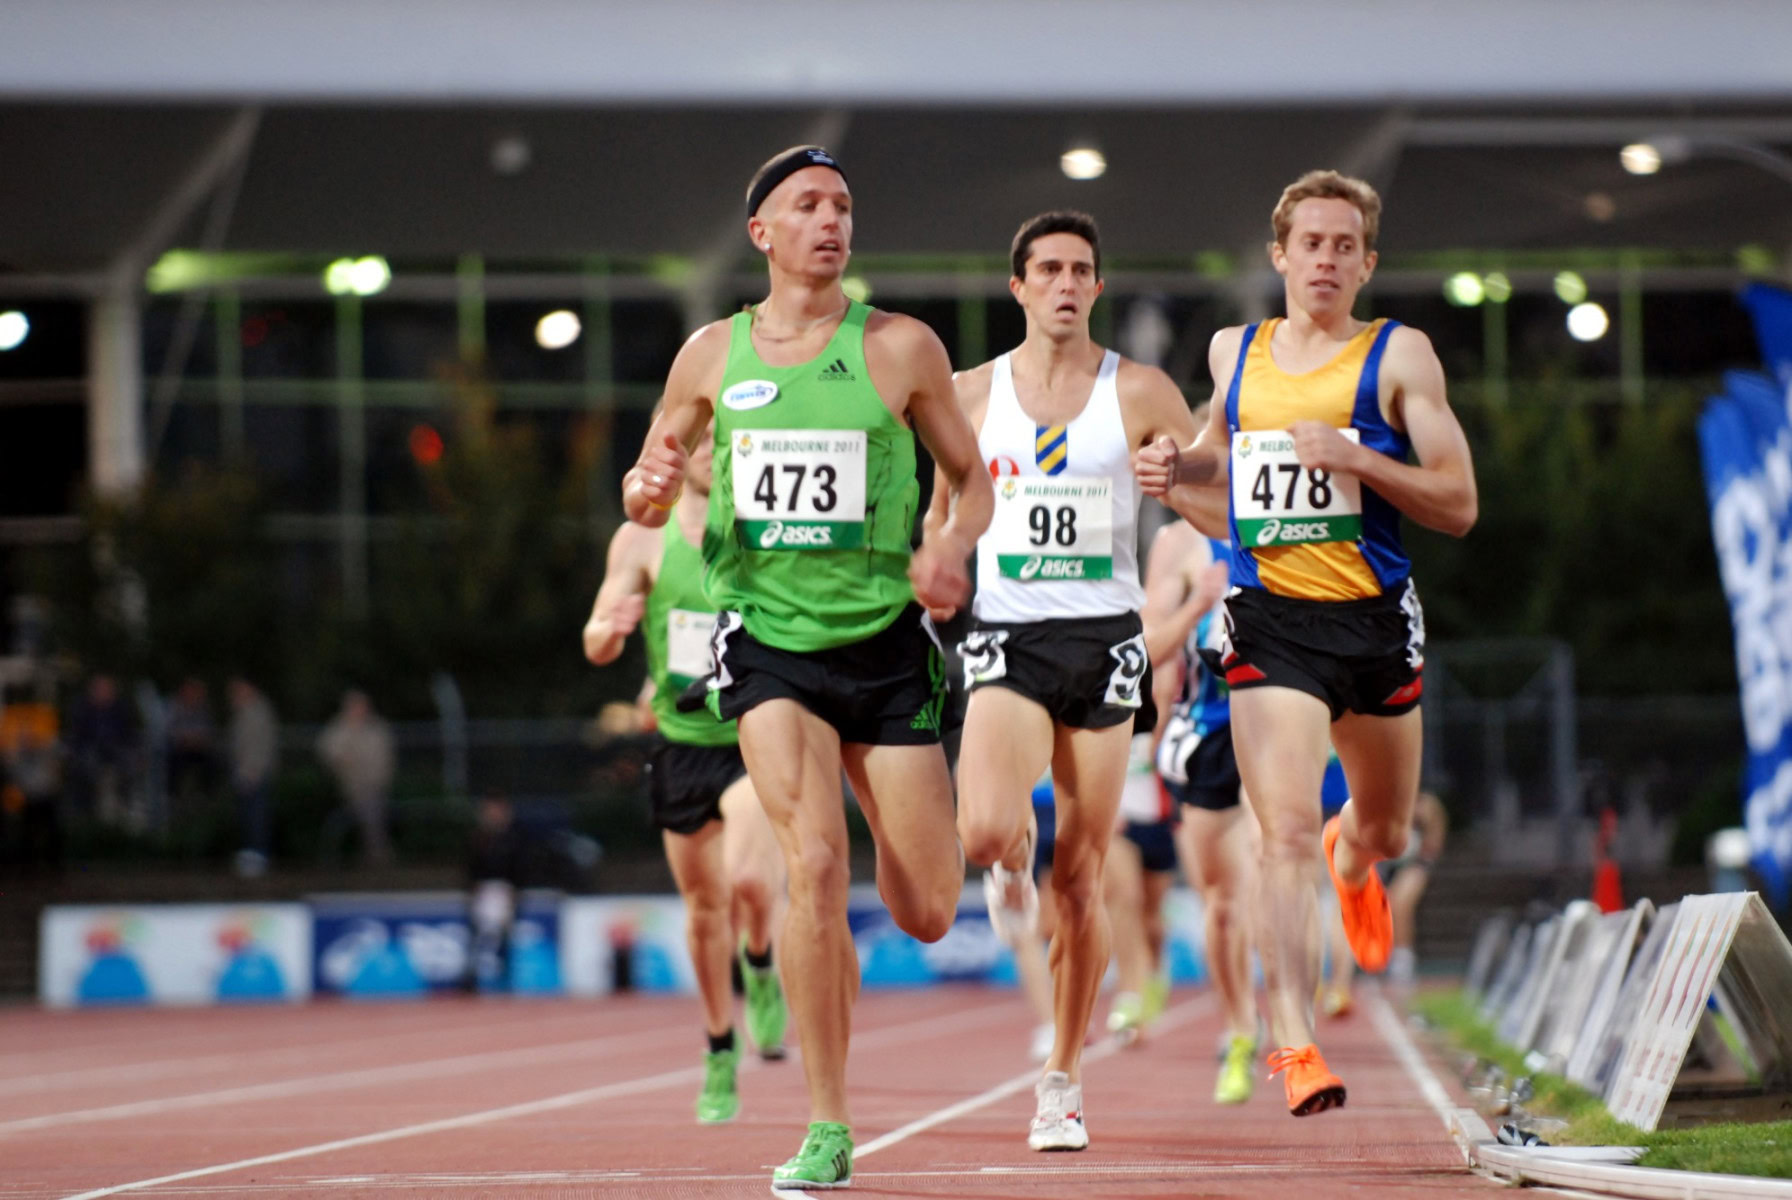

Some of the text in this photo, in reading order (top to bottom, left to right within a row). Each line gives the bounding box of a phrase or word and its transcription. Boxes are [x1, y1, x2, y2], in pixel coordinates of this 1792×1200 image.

[761, 439, 860, 453] MELBOURNE 2011
[1259, 440, 1294, 452] MELBO
[754, 463, 837, 513] 473
[1024, 485, 1082, 497] MELBOURNE
[1251, 463, 1332, 510] 478
[782, 525, 832, 545] asics
[1029, 504, 1077, 547] 98
[1279, 522, 1329, 540] asics
[1041, 558, 1084, 578] asics
